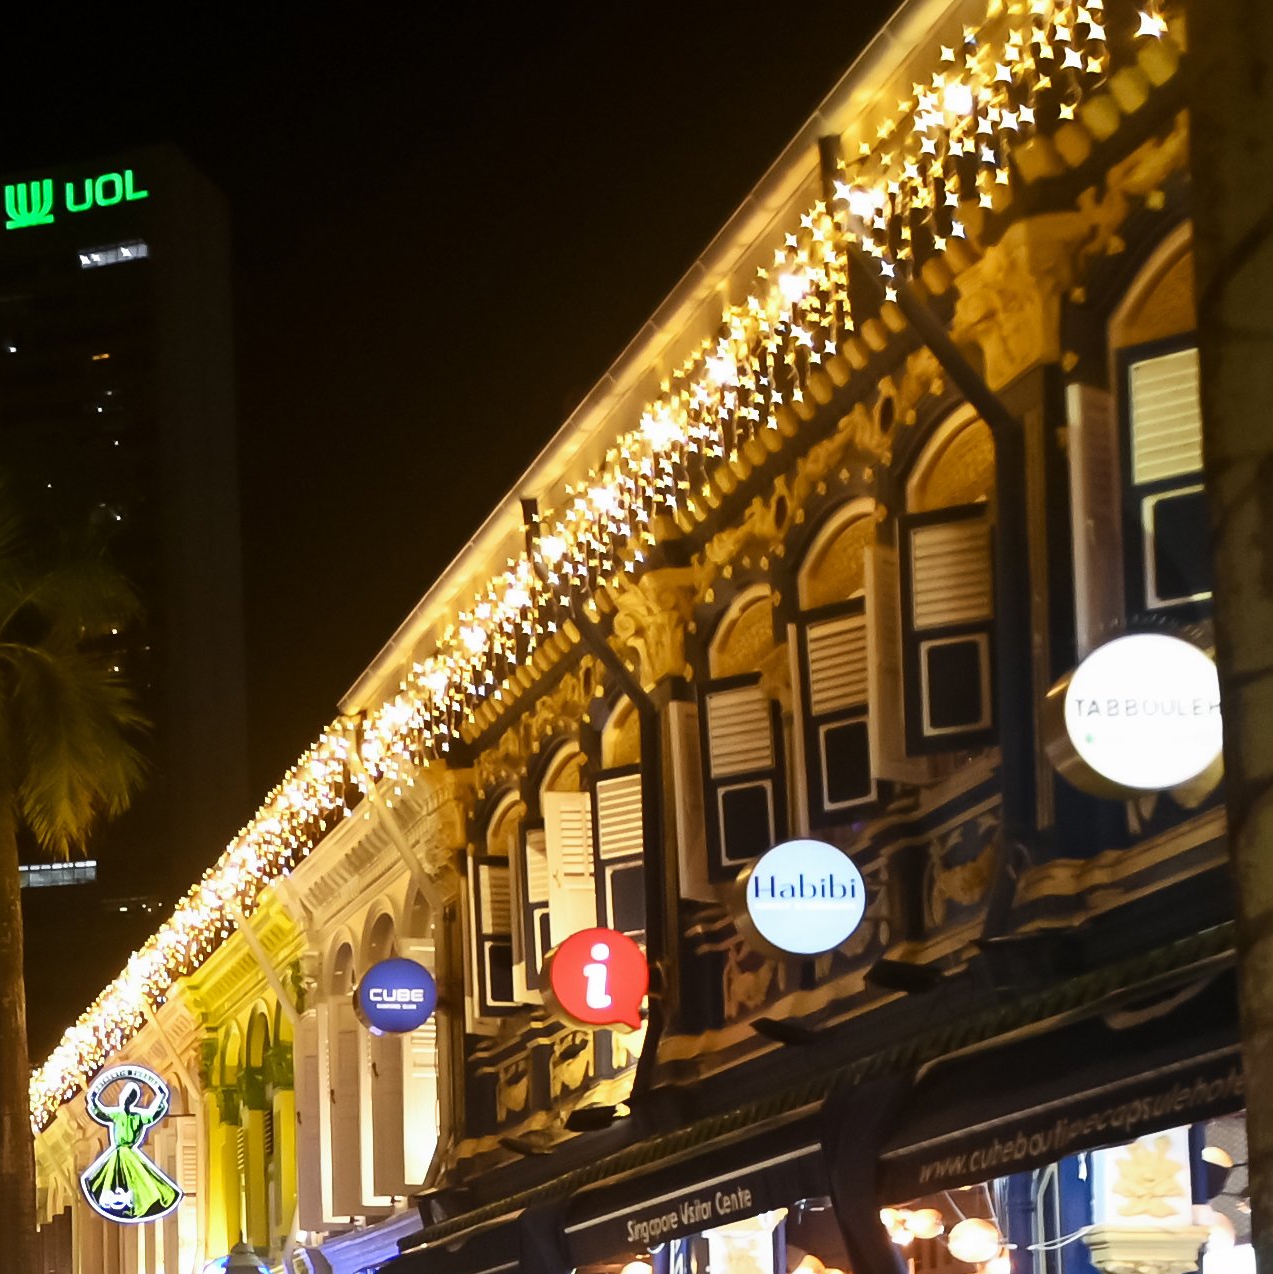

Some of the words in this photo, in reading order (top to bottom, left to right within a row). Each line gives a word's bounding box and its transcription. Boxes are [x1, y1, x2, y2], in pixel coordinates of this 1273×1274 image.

[65, 169, 149, 213] UOL
[755, 873, 855, 898] Habibi
[369, 988, 424, 1003] CUBE
[627, 1210, 679, 1243] Singapore
[679, 1200, 712, 1225] Visitor
[715, 1186, 752, 1215] Centre
